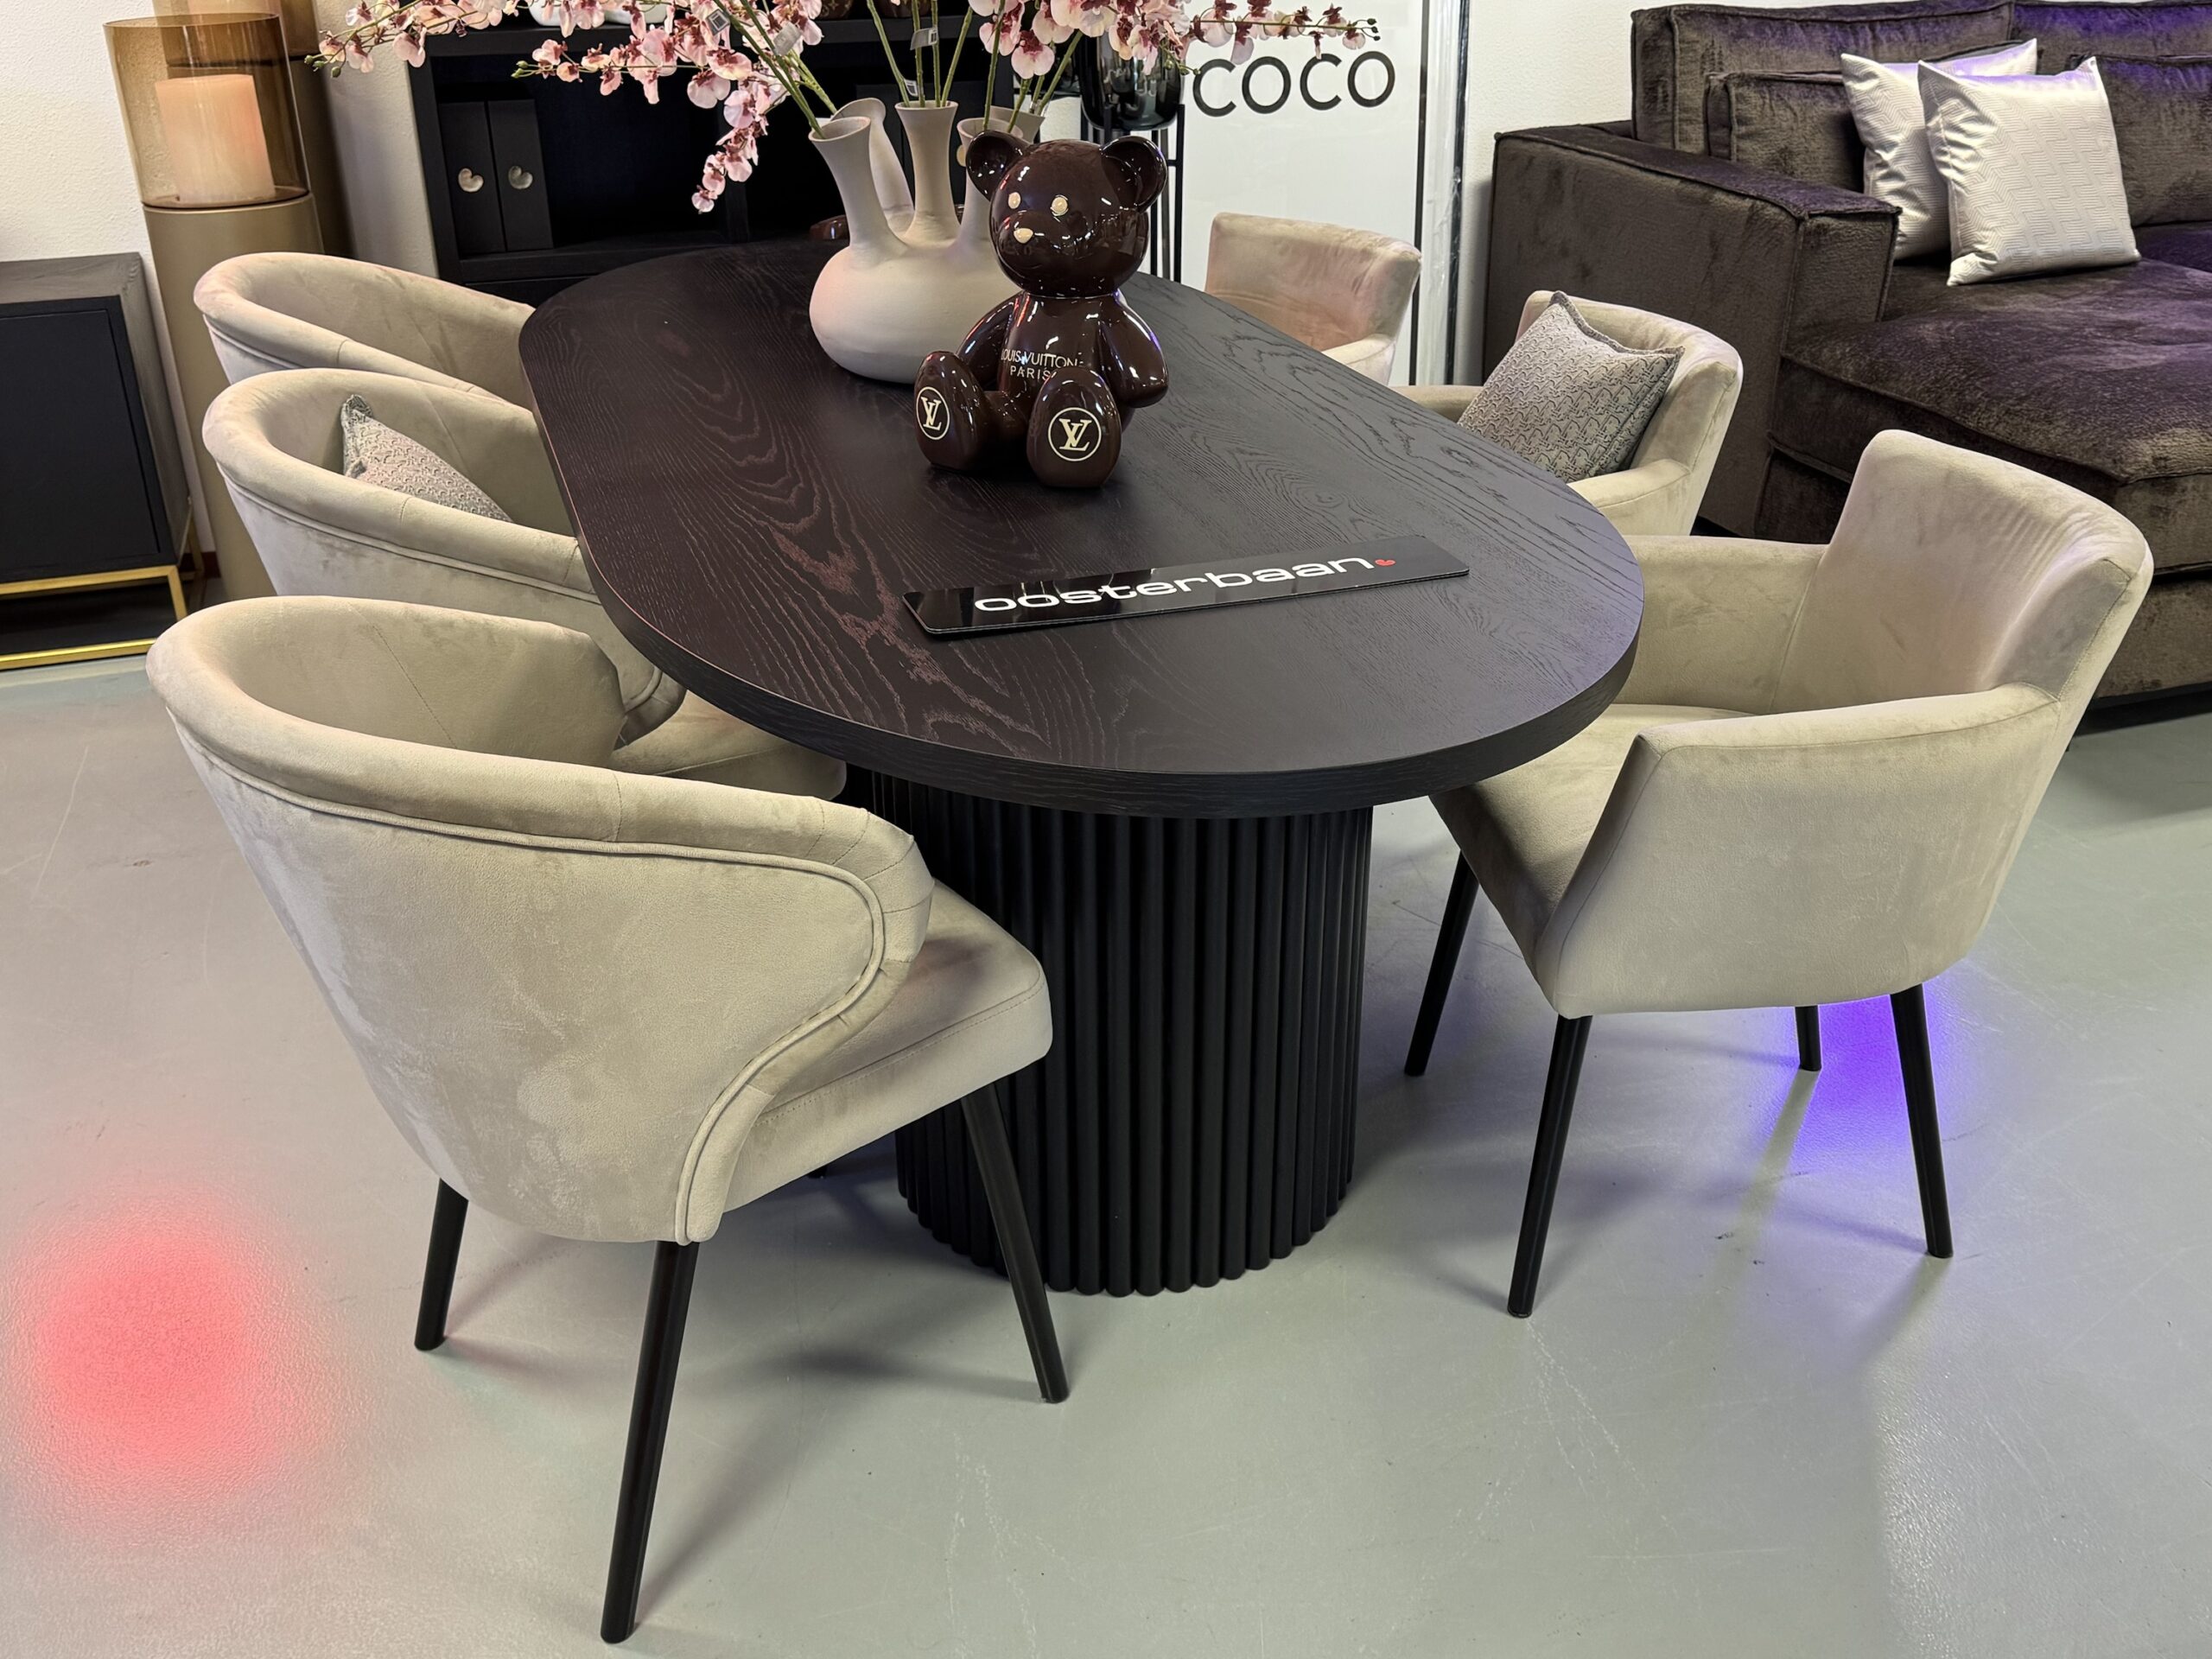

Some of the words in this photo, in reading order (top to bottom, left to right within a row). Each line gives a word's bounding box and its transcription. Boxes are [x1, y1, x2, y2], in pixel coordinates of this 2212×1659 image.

[1192, 51, 1395, 118] COCO
[1001, 348, 1021, 363] LOUIS
[1023, 351, 1078, 369] VUITTON
[1009, 365, 1052, 381] PARIS
[974, 556, 1375, 613] oosterbaan
